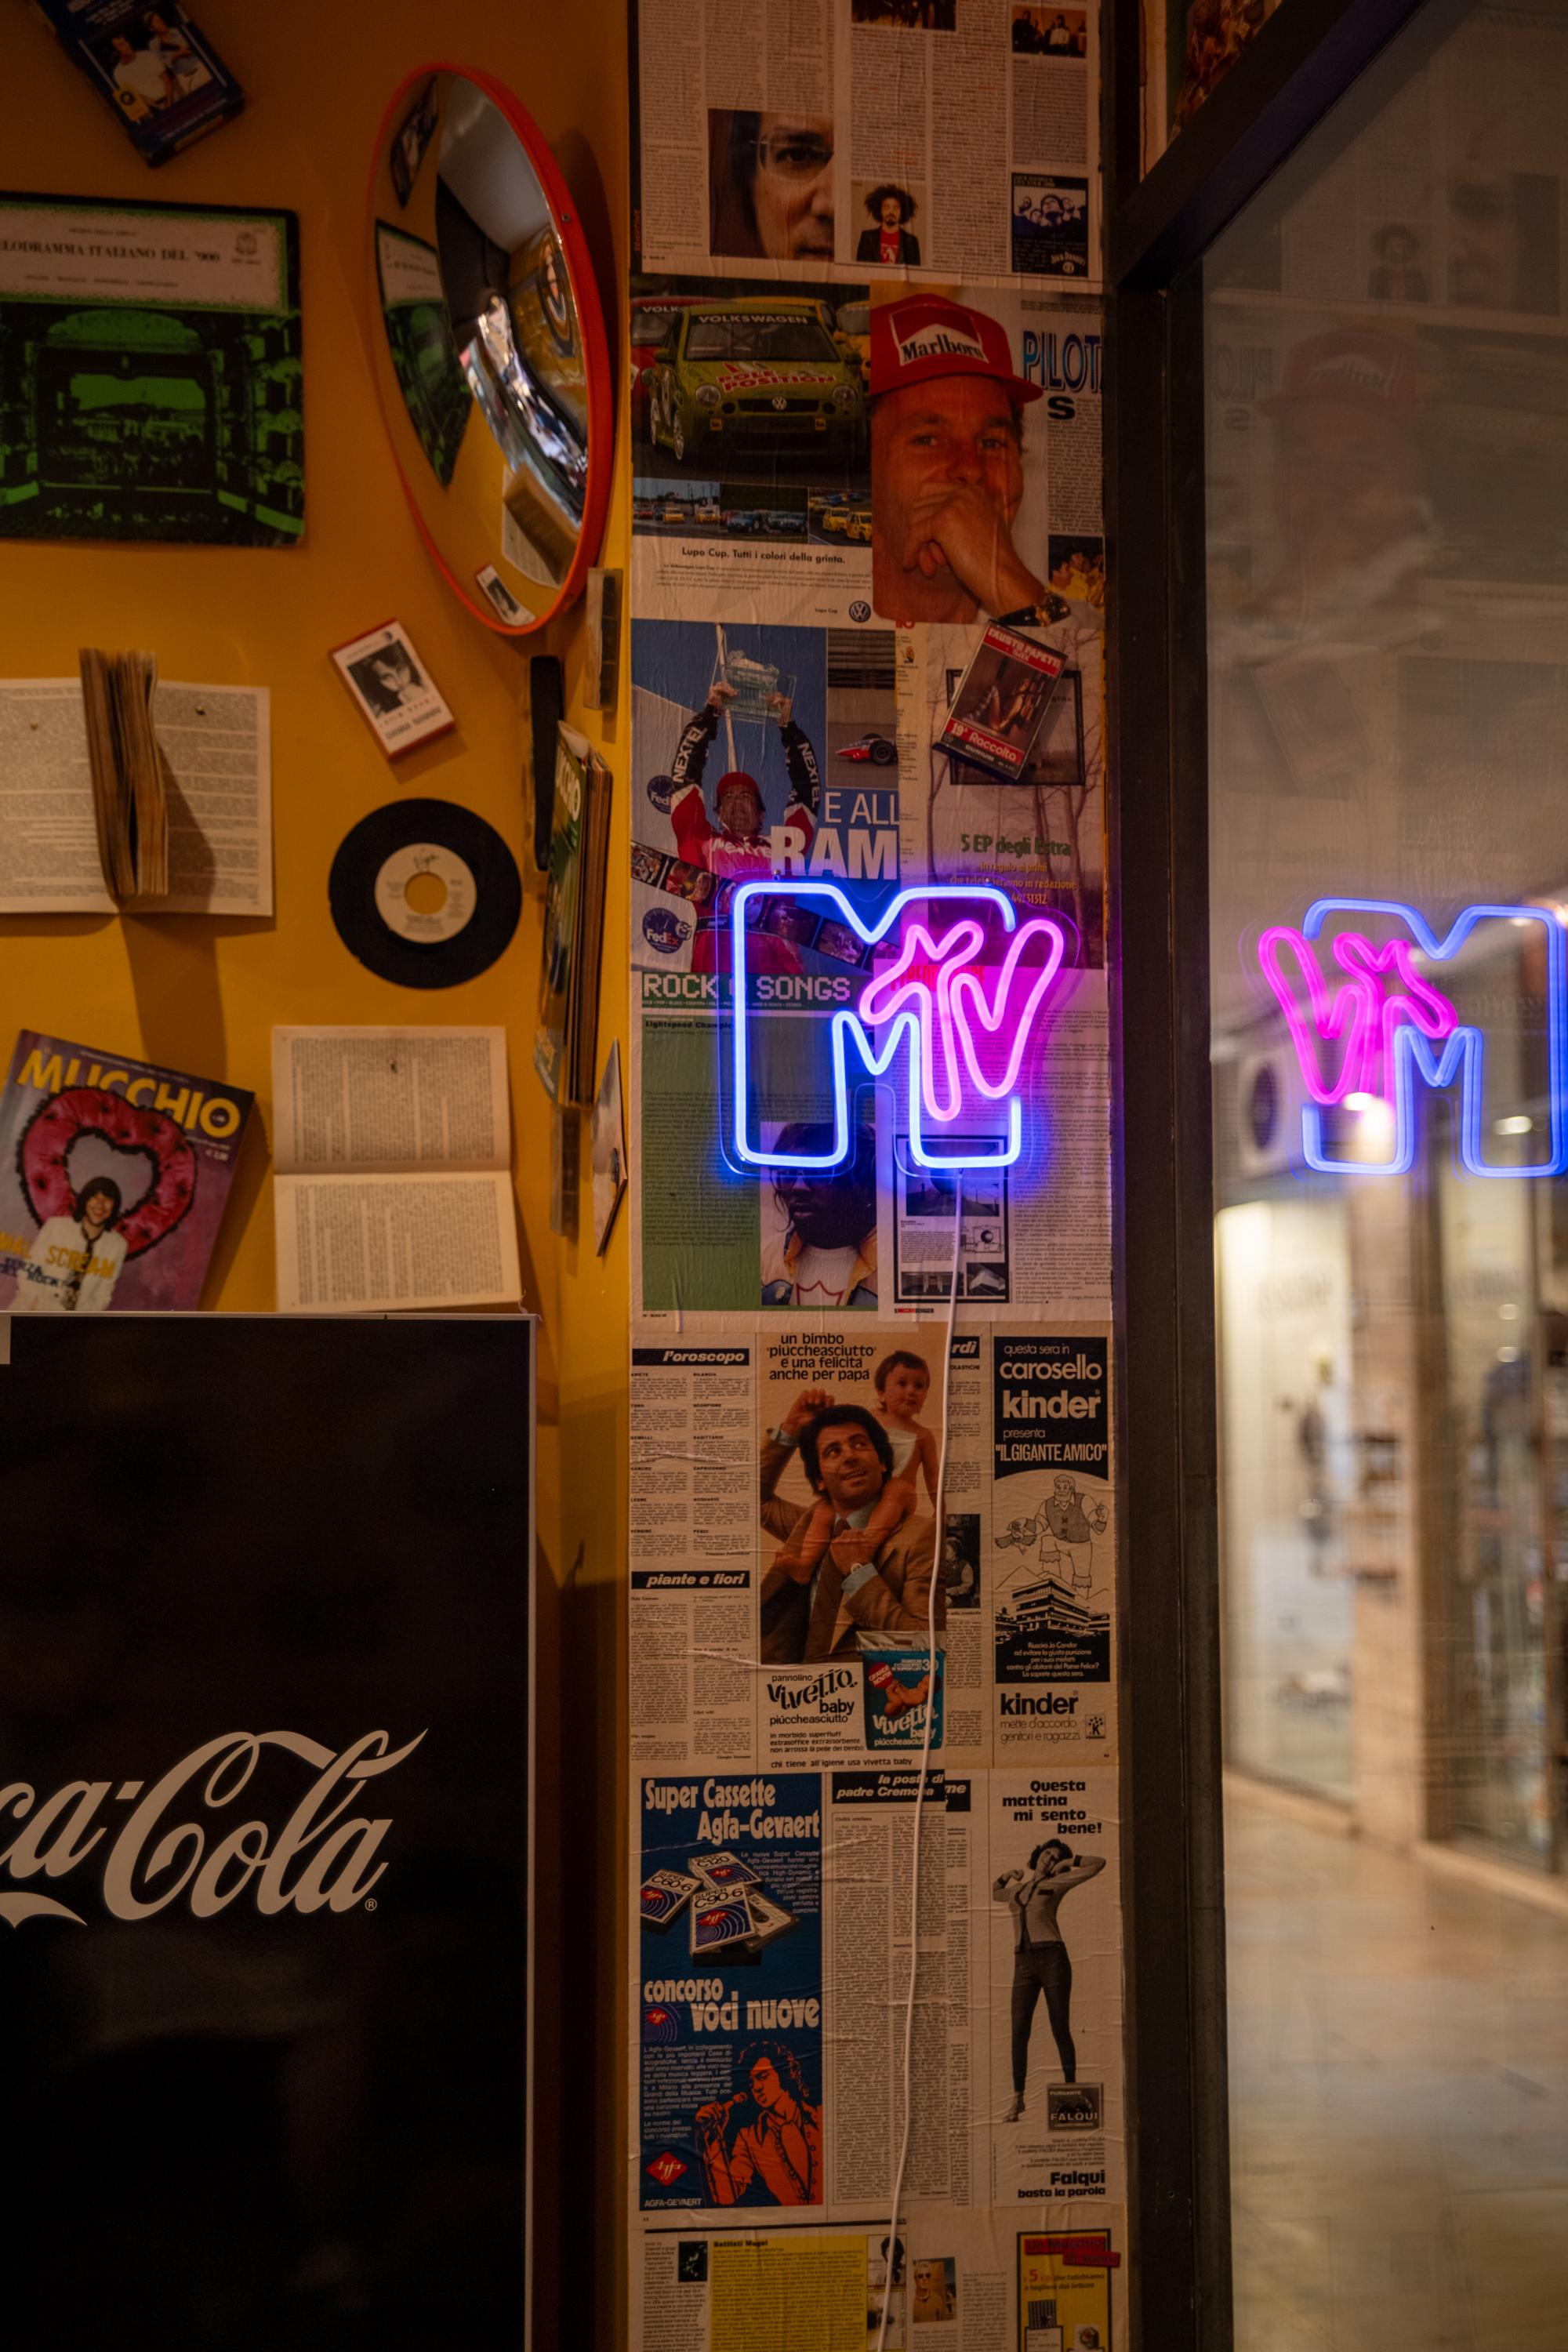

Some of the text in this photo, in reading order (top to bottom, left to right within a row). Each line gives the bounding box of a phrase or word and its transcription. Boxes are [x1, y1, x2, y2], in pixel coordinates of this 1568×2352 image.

[89, 245, 156, 260] ITALIANO
[162, 249, 188, 261] DEL
[698, 315, 808, 325] VOLKSWAGEN
[1023, 330, 1104, 392] PILOT
[722, 374, 837, 392] POSITION
[682, 546, 706, 560] Lupo
[708, 547, 729, 561] Cup.
[734, 549, 753, 560] Tutti
[760, 550, 786, 561] colori
[789, 552, 813, 562] della
[815, 553, 847, 565] grinta.
[968, 731, 1018, 761] Raccolta
[672, 726, 706, 783] NEXTEL
[797, 742, 820, 808] NEXTEL
[770, 825, 898, 880] RAM
[960, 833, 971, 854] 5
[973, 833, 993, 853] EP
[996, 835, 1032, 858] degli
[643, 973, 851, 1002] ROCK SONGS
[645, 1020, 734, 1032] Lightspeed Champio
[731, 879, 1066, 1171] MTV
[16, 1048, 241, 1139] MUCCHIO
[45, 1244, 116, 1279] SCREAM
[781, 1333, 845, 1345] un bimbo
[662, 1348, 746, 1365] l'oroscopo
[1004, 1343, 1071, 1357] questa sera in
[792, 1358, 815, 1369] una
[999, 1353, 1103, 1381] carosello
[769, 1367, 809, 1381] anche
[812, 1370, 835, 1382] per
[1003, 1389, 1102, 1420] kinder
[1003, 1427, 1046, 1441] presenta
[1011, 1443, 1062, 1462] GIGANTE
[1063, 1443, 1108, 1462] AMICO"
[645, 1573, 745, 1588] piante e fiori
[771, 1673, 813, 1682] pannolino
[819, 1697, 855, 1716] baby
[1000, 1693, 1079, 1715] kinder
[1000, 1716, 1077, 1730] mette d'accordo
[770, 1738, 811, 1747] extrasoffice
[844, 1744, 865, 1752] bimbo
[771, 1760, 783, 1769] chi
[786, 1759, 807, 1768] tiene
[863, 1758, 891, 1766] vivetta
[893, 1756, 913, 1766] baby
[878, 1773, 944, 1786] la post di
[1030, 1779, 1087, 1793] Questa
[644, 1777, 777, 1816] Super Cassette
[836, 1786, 935, 1800] padre Cremoa
[1002, 1794, 1068, 1807] mattina
[1013, 1809, 1087, 1821] mi sento
[0, 1727, 430, 1925] ca-Cola
[696, 1807, 821, 1847] Agfa-Gevaert
[1057, 1822, 1102, 1835] bene!
[696, 1855, 730, 1868] C120
[695, 1887, 728, 1900] SUPER
[644, 1977, 724, 2003] concorso
[690, 1990, 821, 2032] voci nuove
[1051, 2111, 1098, 2122] FALQUI
[652, 2159, 681, 2181] Agfa
[1051, 2169, 1106, 2187] Falqui
[1018, 2186, 1106, 2199] basta la parola
[644, 2197, 703, 2209] AGFA-GEVAERT
